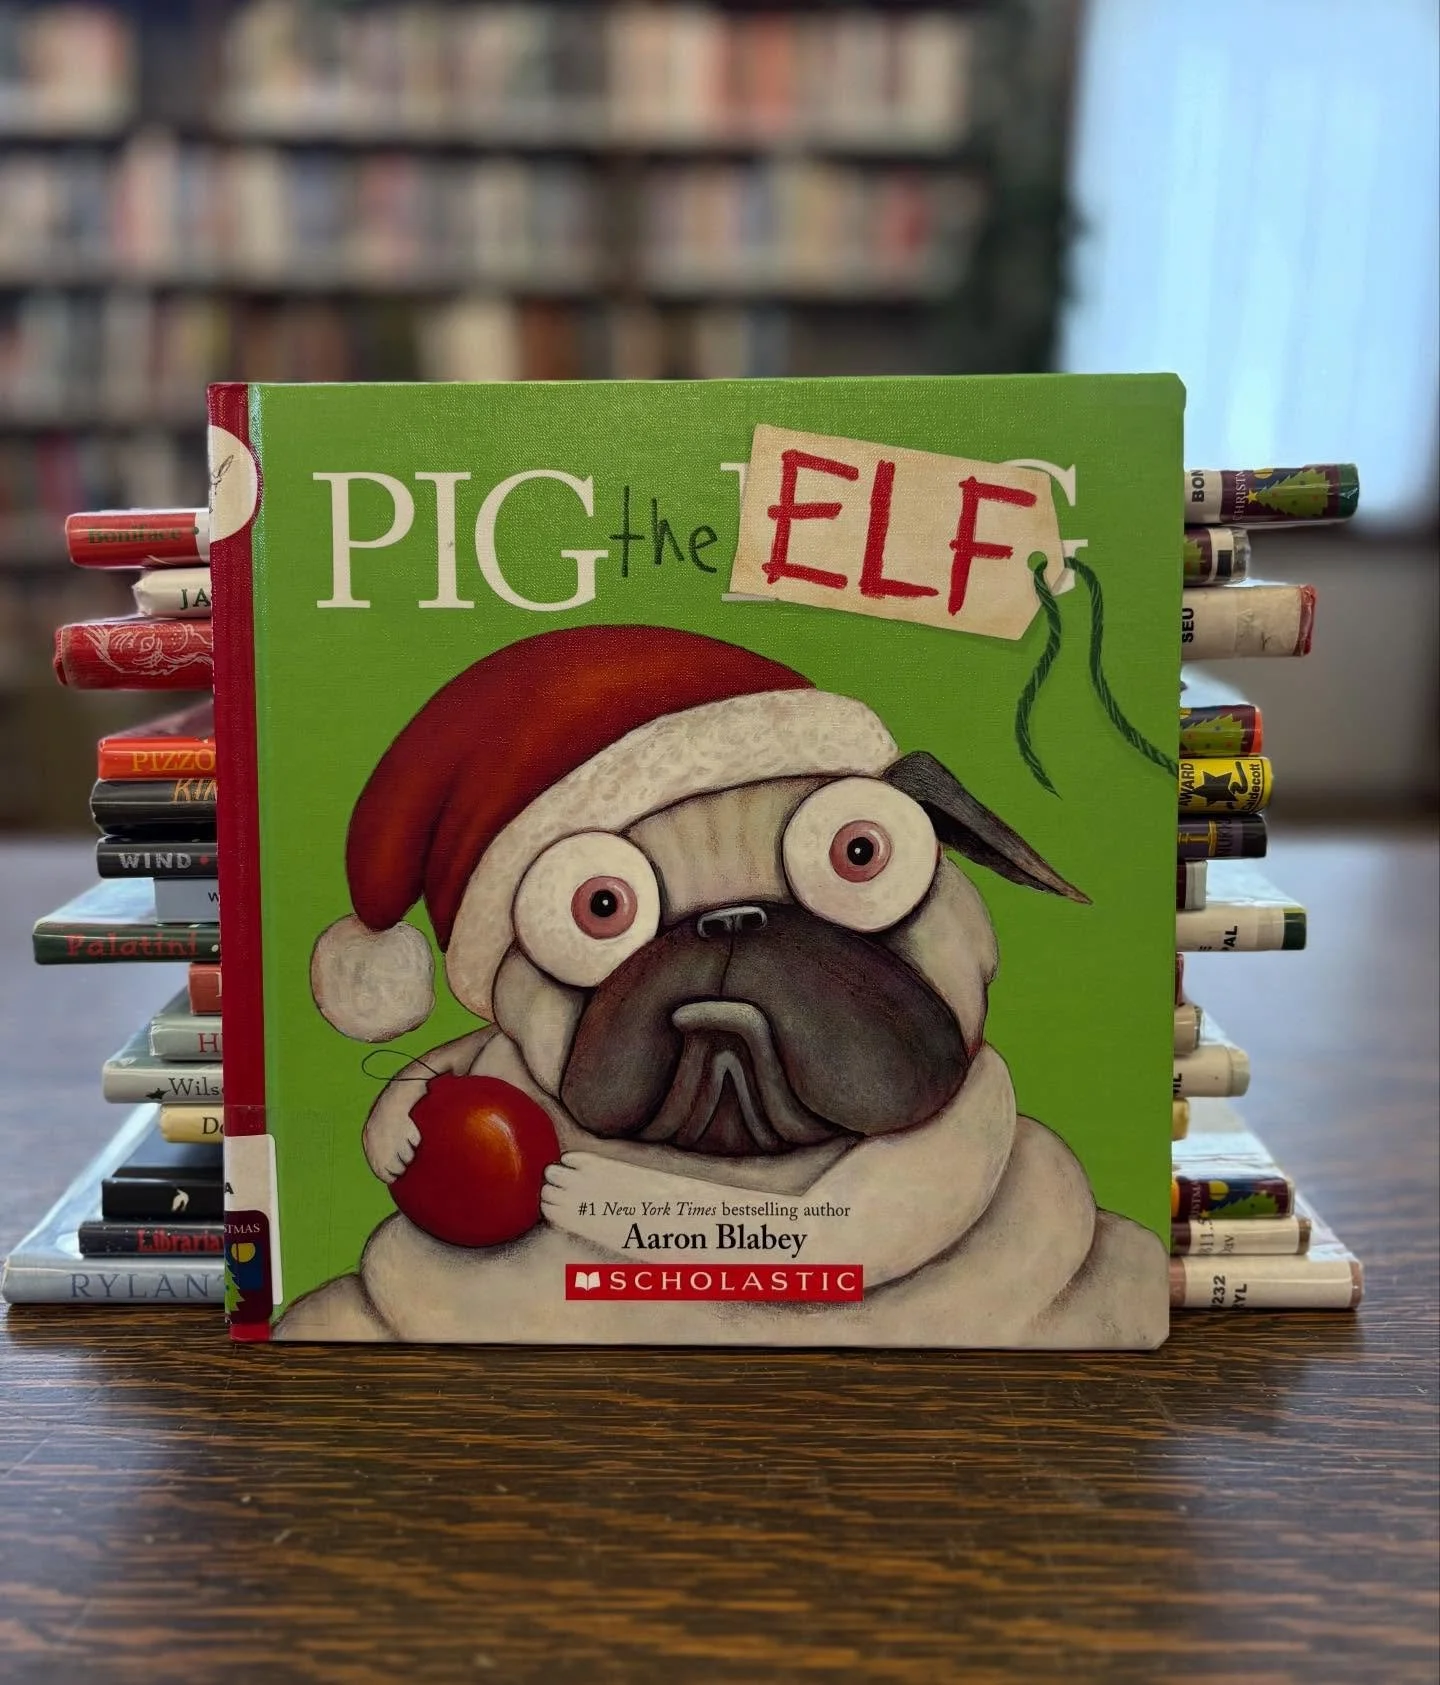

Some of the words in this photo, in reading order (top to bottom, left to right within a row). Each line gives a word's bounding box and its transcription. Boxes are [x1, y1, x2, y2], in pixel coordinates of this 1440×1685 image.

[313, 469, 609, 611] PIG
[609, 485, 717, 578] the
[762, 449, 1038, 616] ELF
[1181, 607, 1194, 643] SEU
[117, 853, 193, 869] WIND
[65, 930, 200, 957] Palatini
[577, 1202, 597, 1216] #1
[603, 1202, 636, 1216] New
[641, 1202, 671, 1216] York
[676, 1202, 717, 1216] Times
[721, 1201, 799, 1221] bestselling
[803, 1202, 851, 1217] author
[621, 1222, 707, 1250] Aaron
[715, 1223, 808, 1258] Blabey
[69, 1272, 224, 1298] RYLAN
[609, 1271, 857, 1291] SCHOLASTIC
